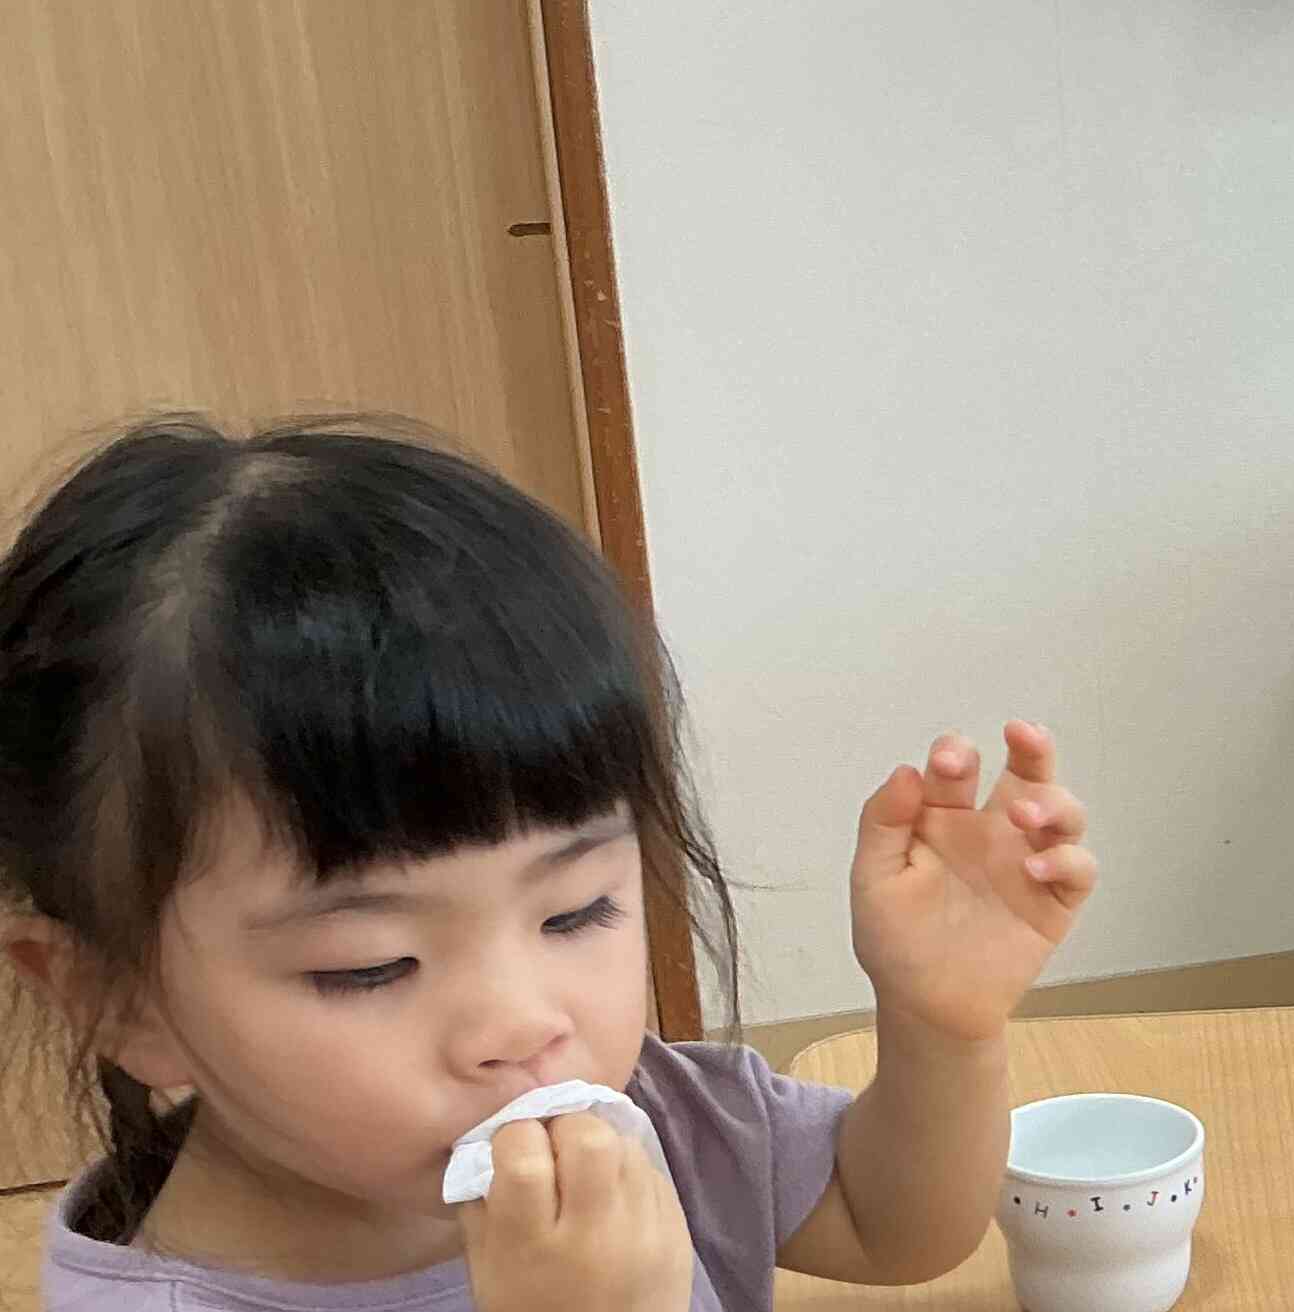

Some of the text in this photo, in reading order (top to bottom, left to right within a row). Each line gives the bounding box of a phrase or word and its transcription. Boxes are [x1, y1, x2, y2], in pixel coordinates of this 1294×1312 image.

[1034, 1202, 1049, 1218] H
[1090, 1196, 1104, 1212] I
[1147, 1191, 1160, 1206] J
